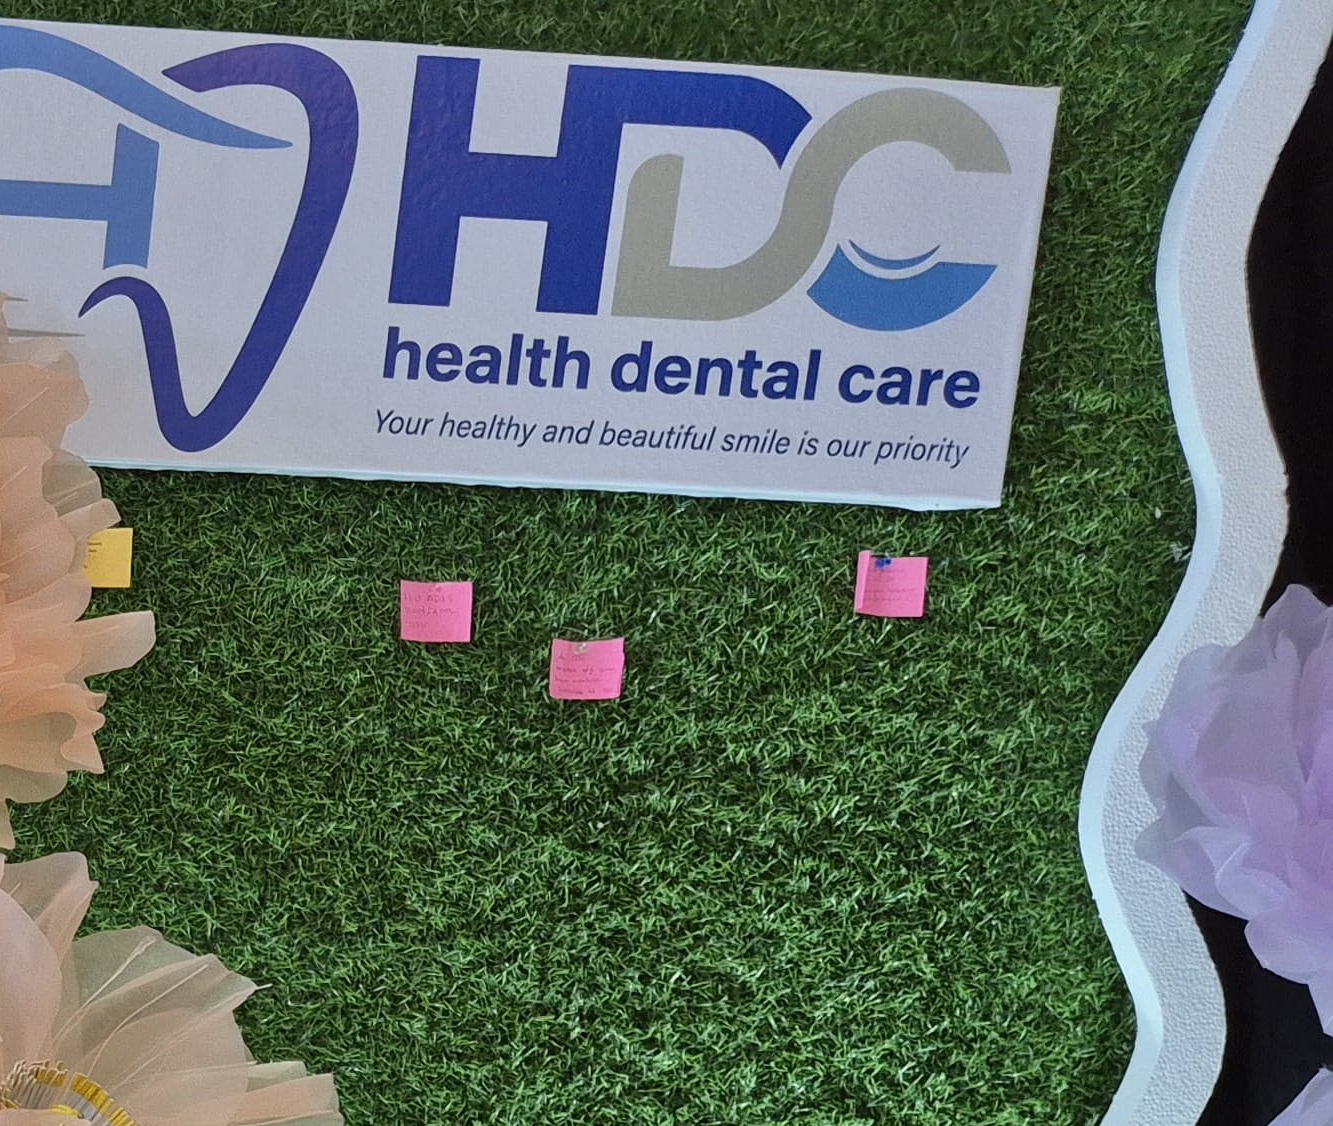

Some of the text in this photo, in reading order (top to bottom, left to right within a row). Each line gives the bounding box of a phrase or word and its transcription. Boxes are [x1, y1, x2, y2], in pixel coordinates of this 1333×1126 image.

[388, 55, 1013, 332] HDC
[382, 326, 981, 410] health dental care
[374, 409, 970, 469] Your healthy and beautiful smile is our priority
